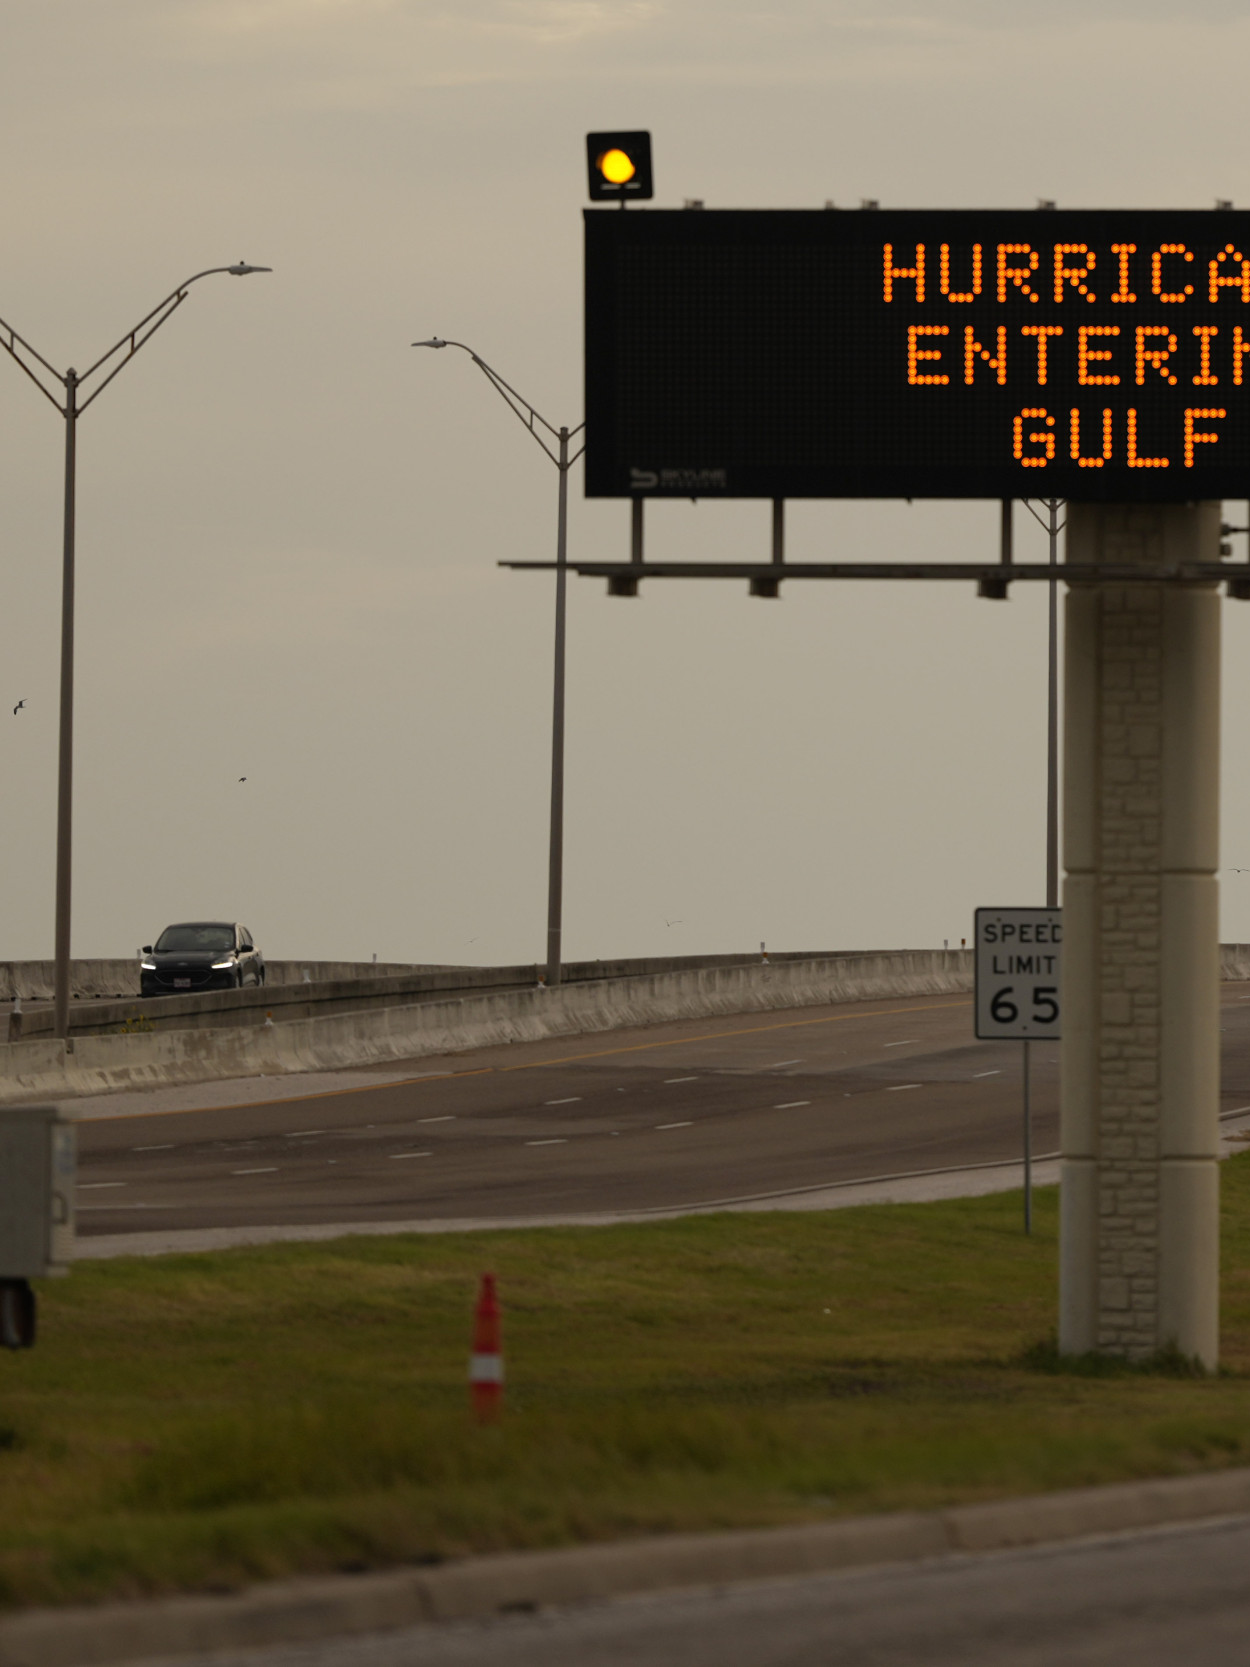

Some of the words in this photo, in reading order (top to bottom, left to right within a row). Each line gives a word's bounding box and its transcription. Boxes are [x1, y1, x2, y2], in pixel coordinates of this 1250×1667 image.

[1012, 407, 1228, 469] GULF
[983, 923, 1062, 944] SPEED
[992, 954, 1057, 975] LIMIT
[990, 986, 1060, 1024] 65
